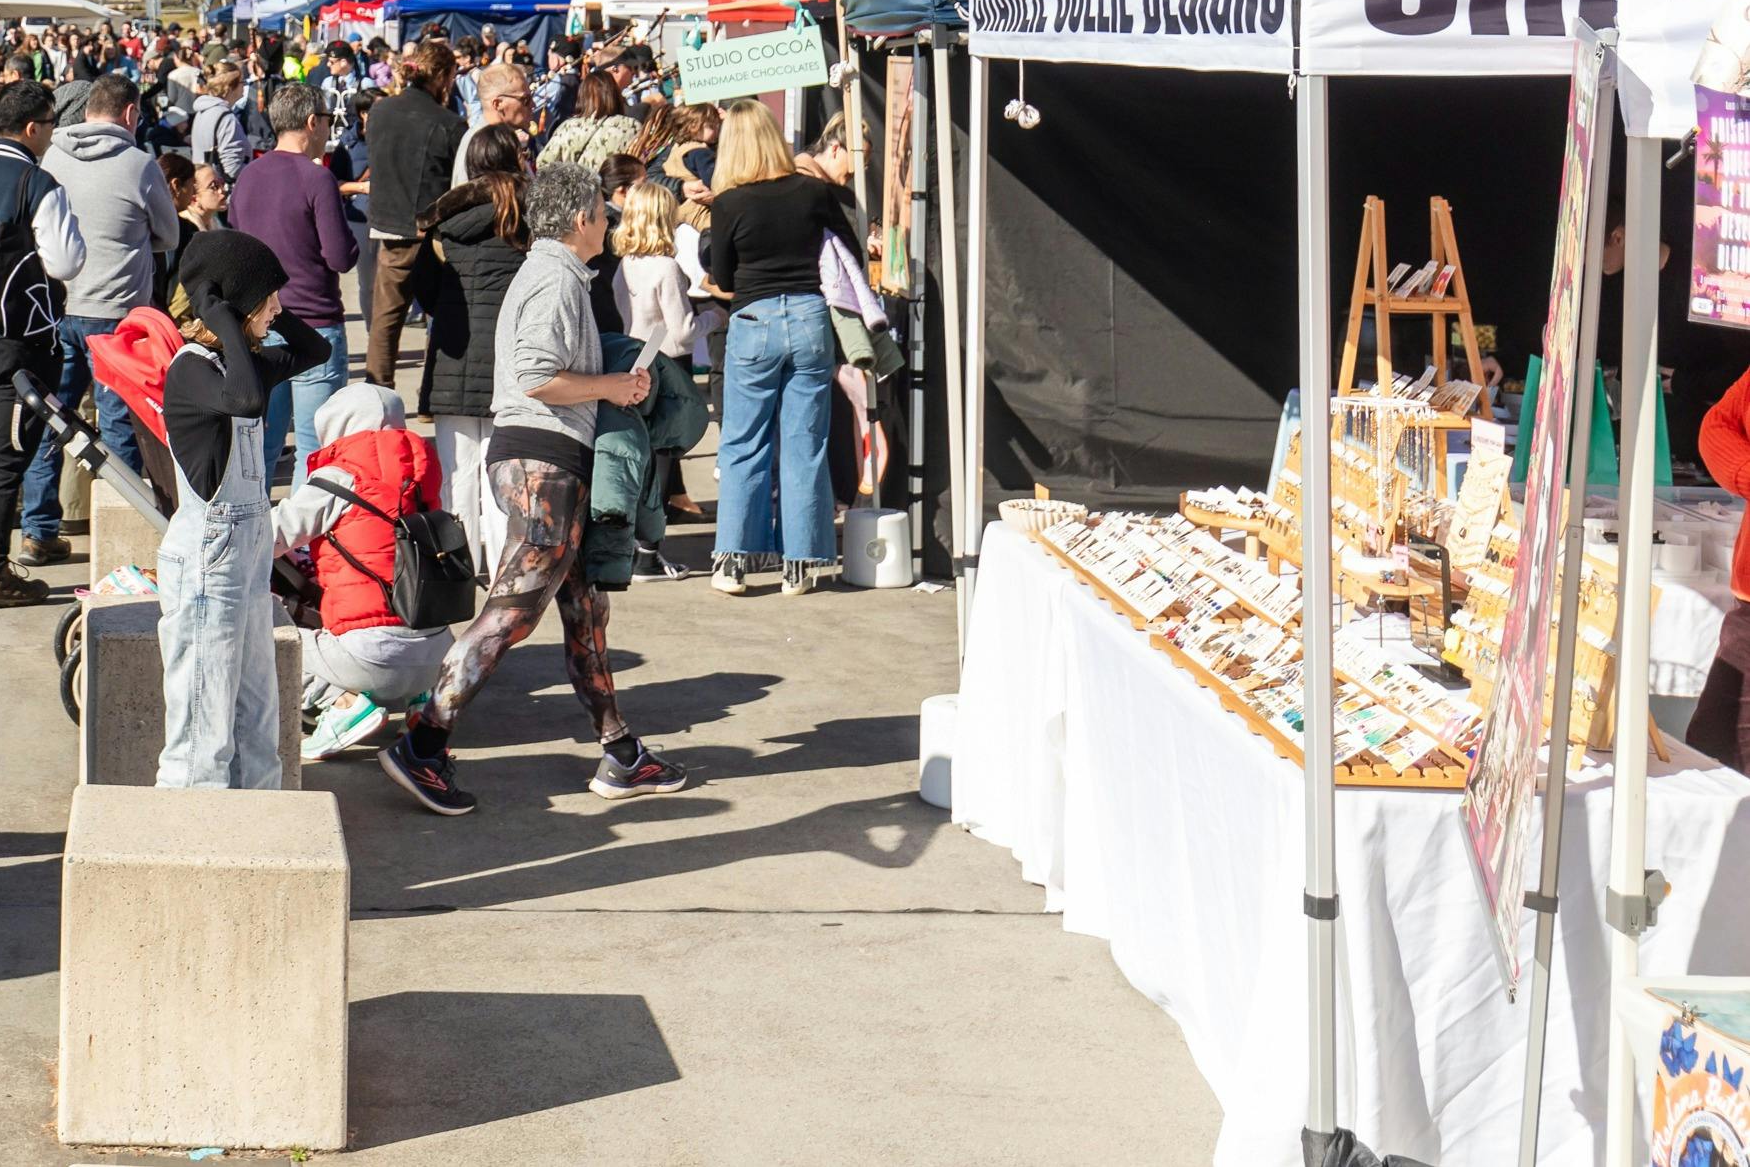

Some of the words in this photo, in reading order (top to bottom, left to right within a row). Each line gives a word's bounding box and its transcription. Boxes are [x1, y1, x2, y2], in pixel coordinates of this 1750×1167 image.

[686, 50, 743, 73] STUDIO
[747, 38, 817, 61] COCOA
[688, 71, 750, 90] HANDMADE
[750, 60, 820, 79] CHOCOLATES
